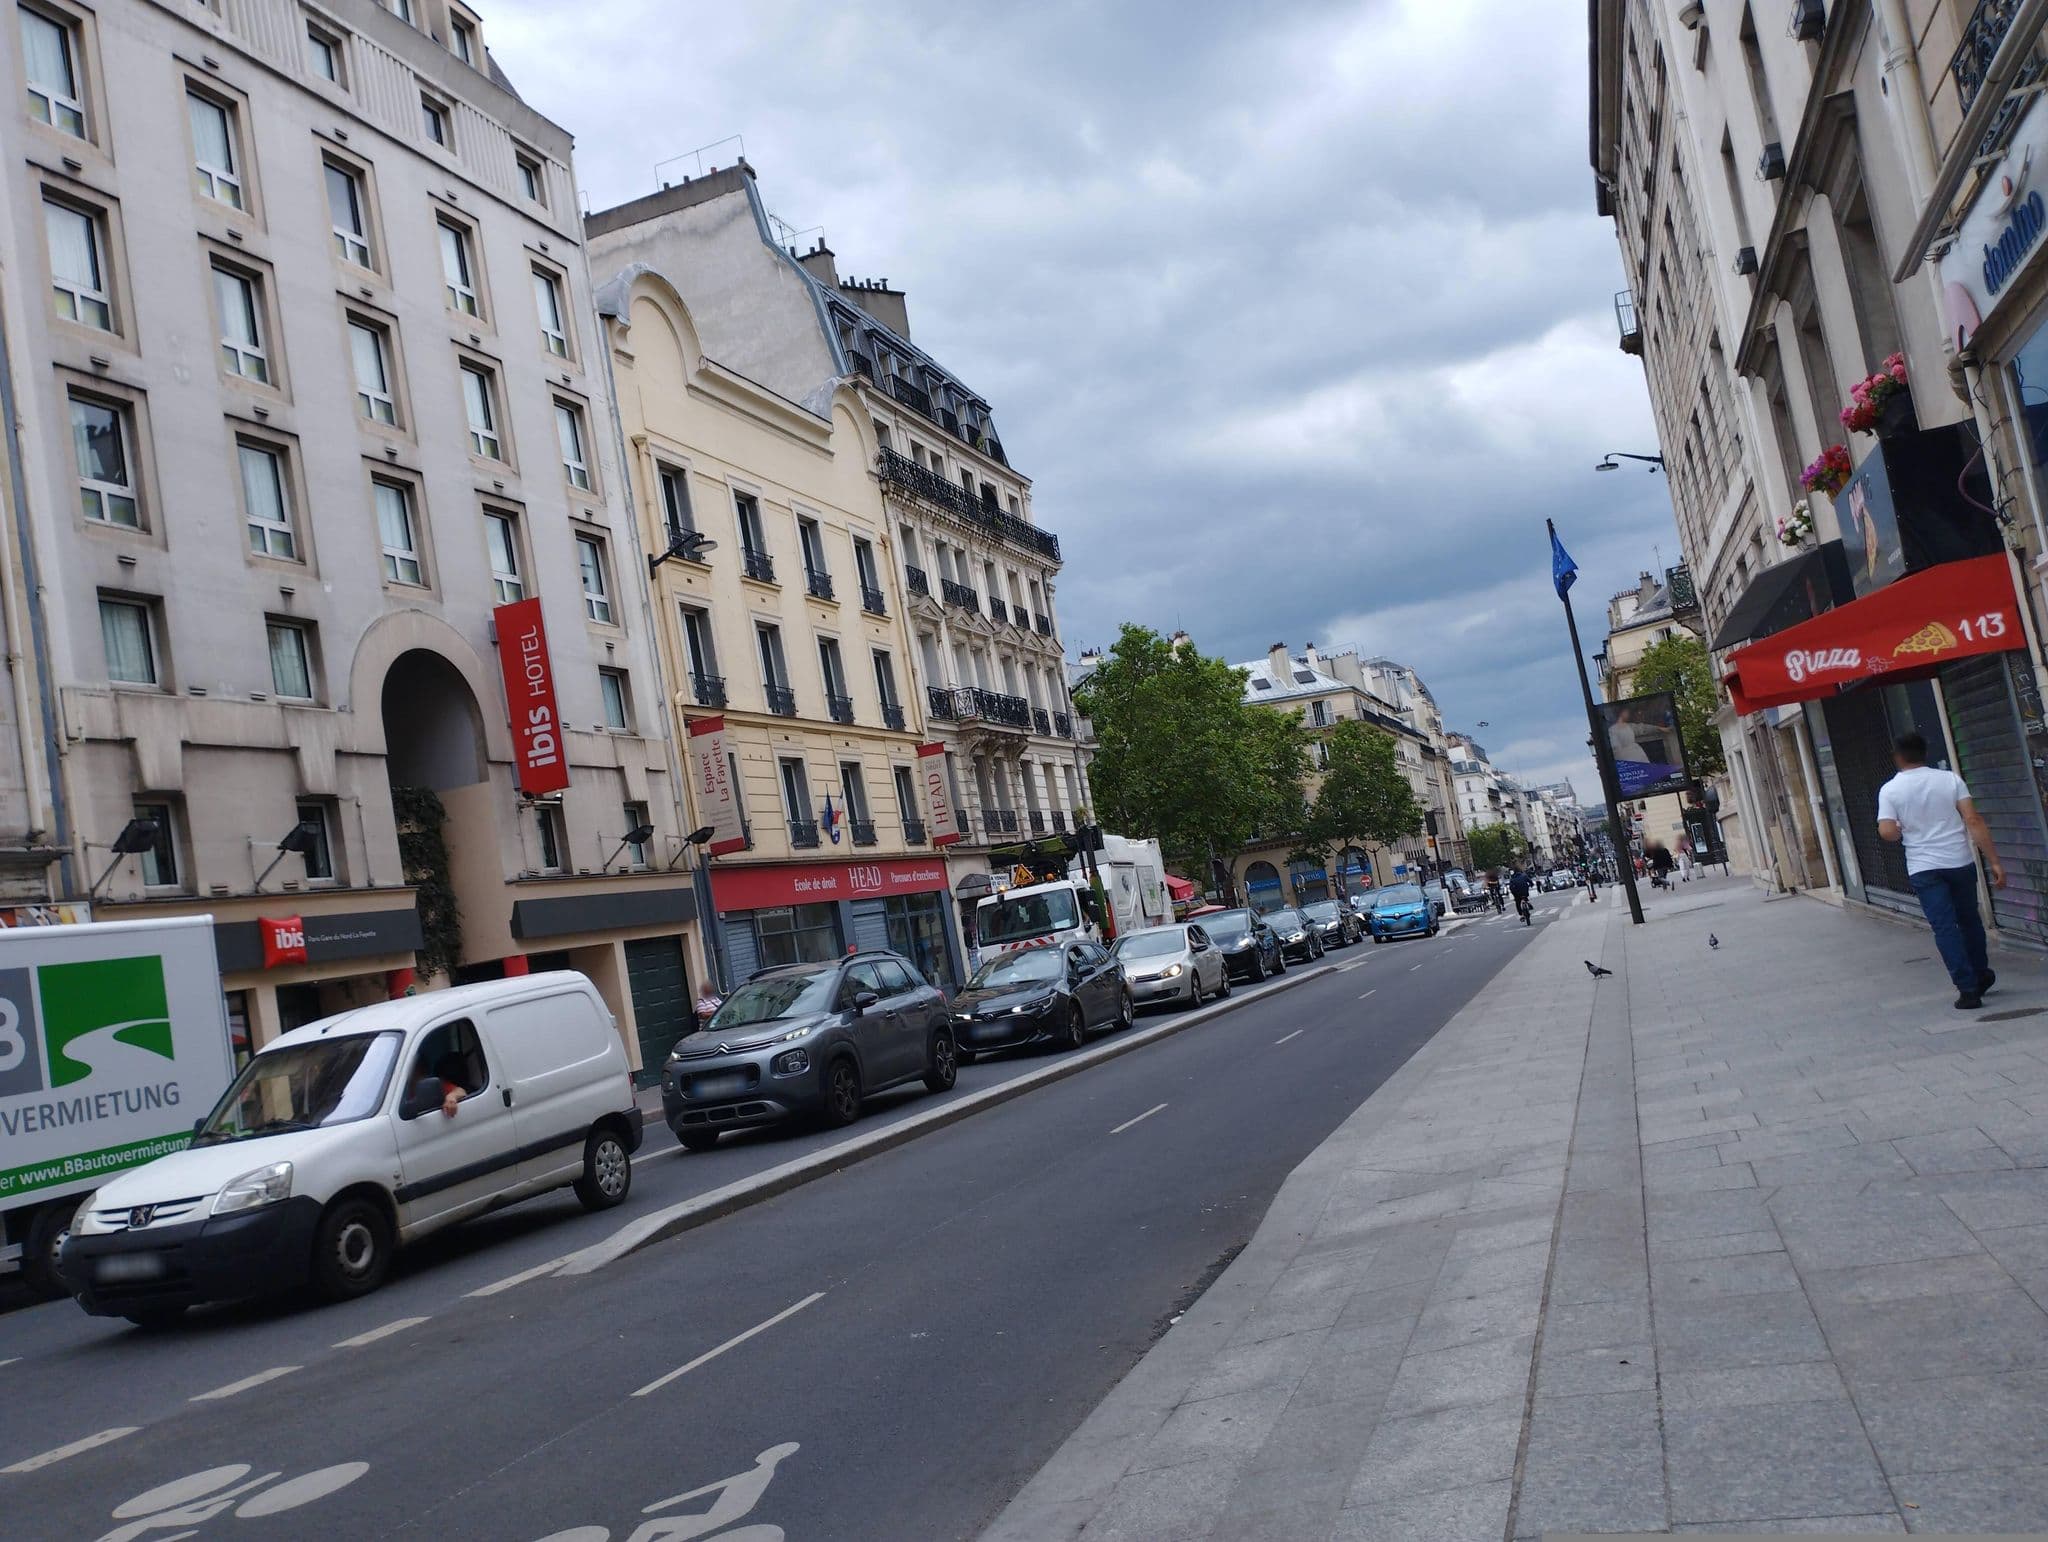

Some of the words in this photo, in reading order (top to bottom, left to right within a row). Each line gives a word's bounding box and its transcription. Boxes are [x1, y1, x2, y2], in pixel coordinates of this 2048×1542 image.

[1983, 190, 2046, 296] domino
[520, 624, 546, 697] HOTEL
[1784, 648, 1861, 682] Pizza
[524, 705, 557, 768] ibis
[701, 752, 715, 794] Espace
[711, 740, 727, 785] Fayette
[720, 787, 730, 802] La
[928, 773, 949, 824] HEAD
[812, 878, 821, 890] de
[821, 877, 837, 889] droit
[848, 866, 882, 889] HEAD
[275, 927, 305, 949] ibis
[0, 1081, 180, 1137] VERMIETUNG
